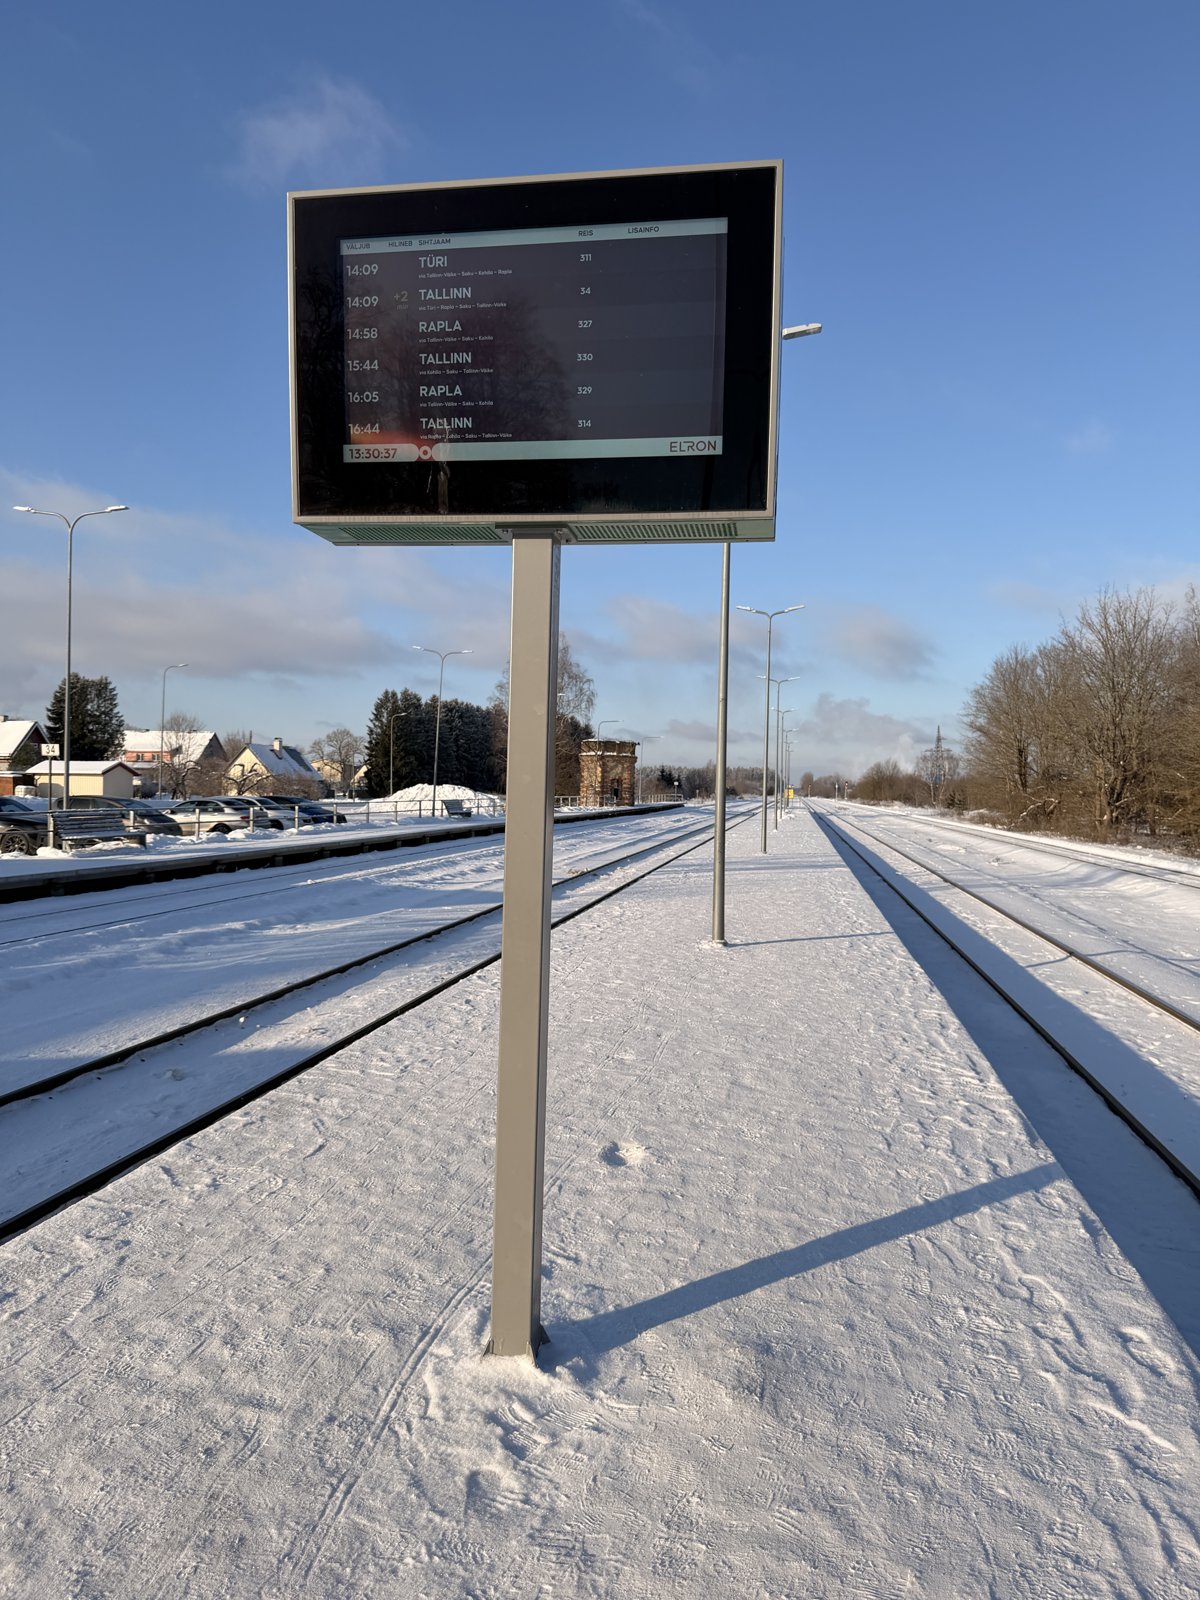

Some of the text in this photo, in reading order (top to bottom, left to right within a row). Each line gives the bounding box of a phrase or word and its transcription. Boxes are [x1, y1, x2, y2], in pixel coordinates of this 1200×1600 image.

[388, 240, 413, 248] HILINEB
[418, 238, 451, 246] SIHTJAAM
[628, 226, 660, 234] LISAINFO
[346, 254, 592, 276] 14:09 TÜRI 311
[346, 287, 591, 308] 14:09 +2 TALLINN 34
[347, 320, 593, 340] 14:58 RAPLA 327
[347, 352, 593, 372] 15:44 TALLINN 330
[348, 385, 593, 403] 16:05 RAPLA 329
[348, 417, 591, 435] 16:44 TALLINN 314
[349, 440, 717, 459] 13:30:37 ELRON
[45, 744, 55, 754] 34
